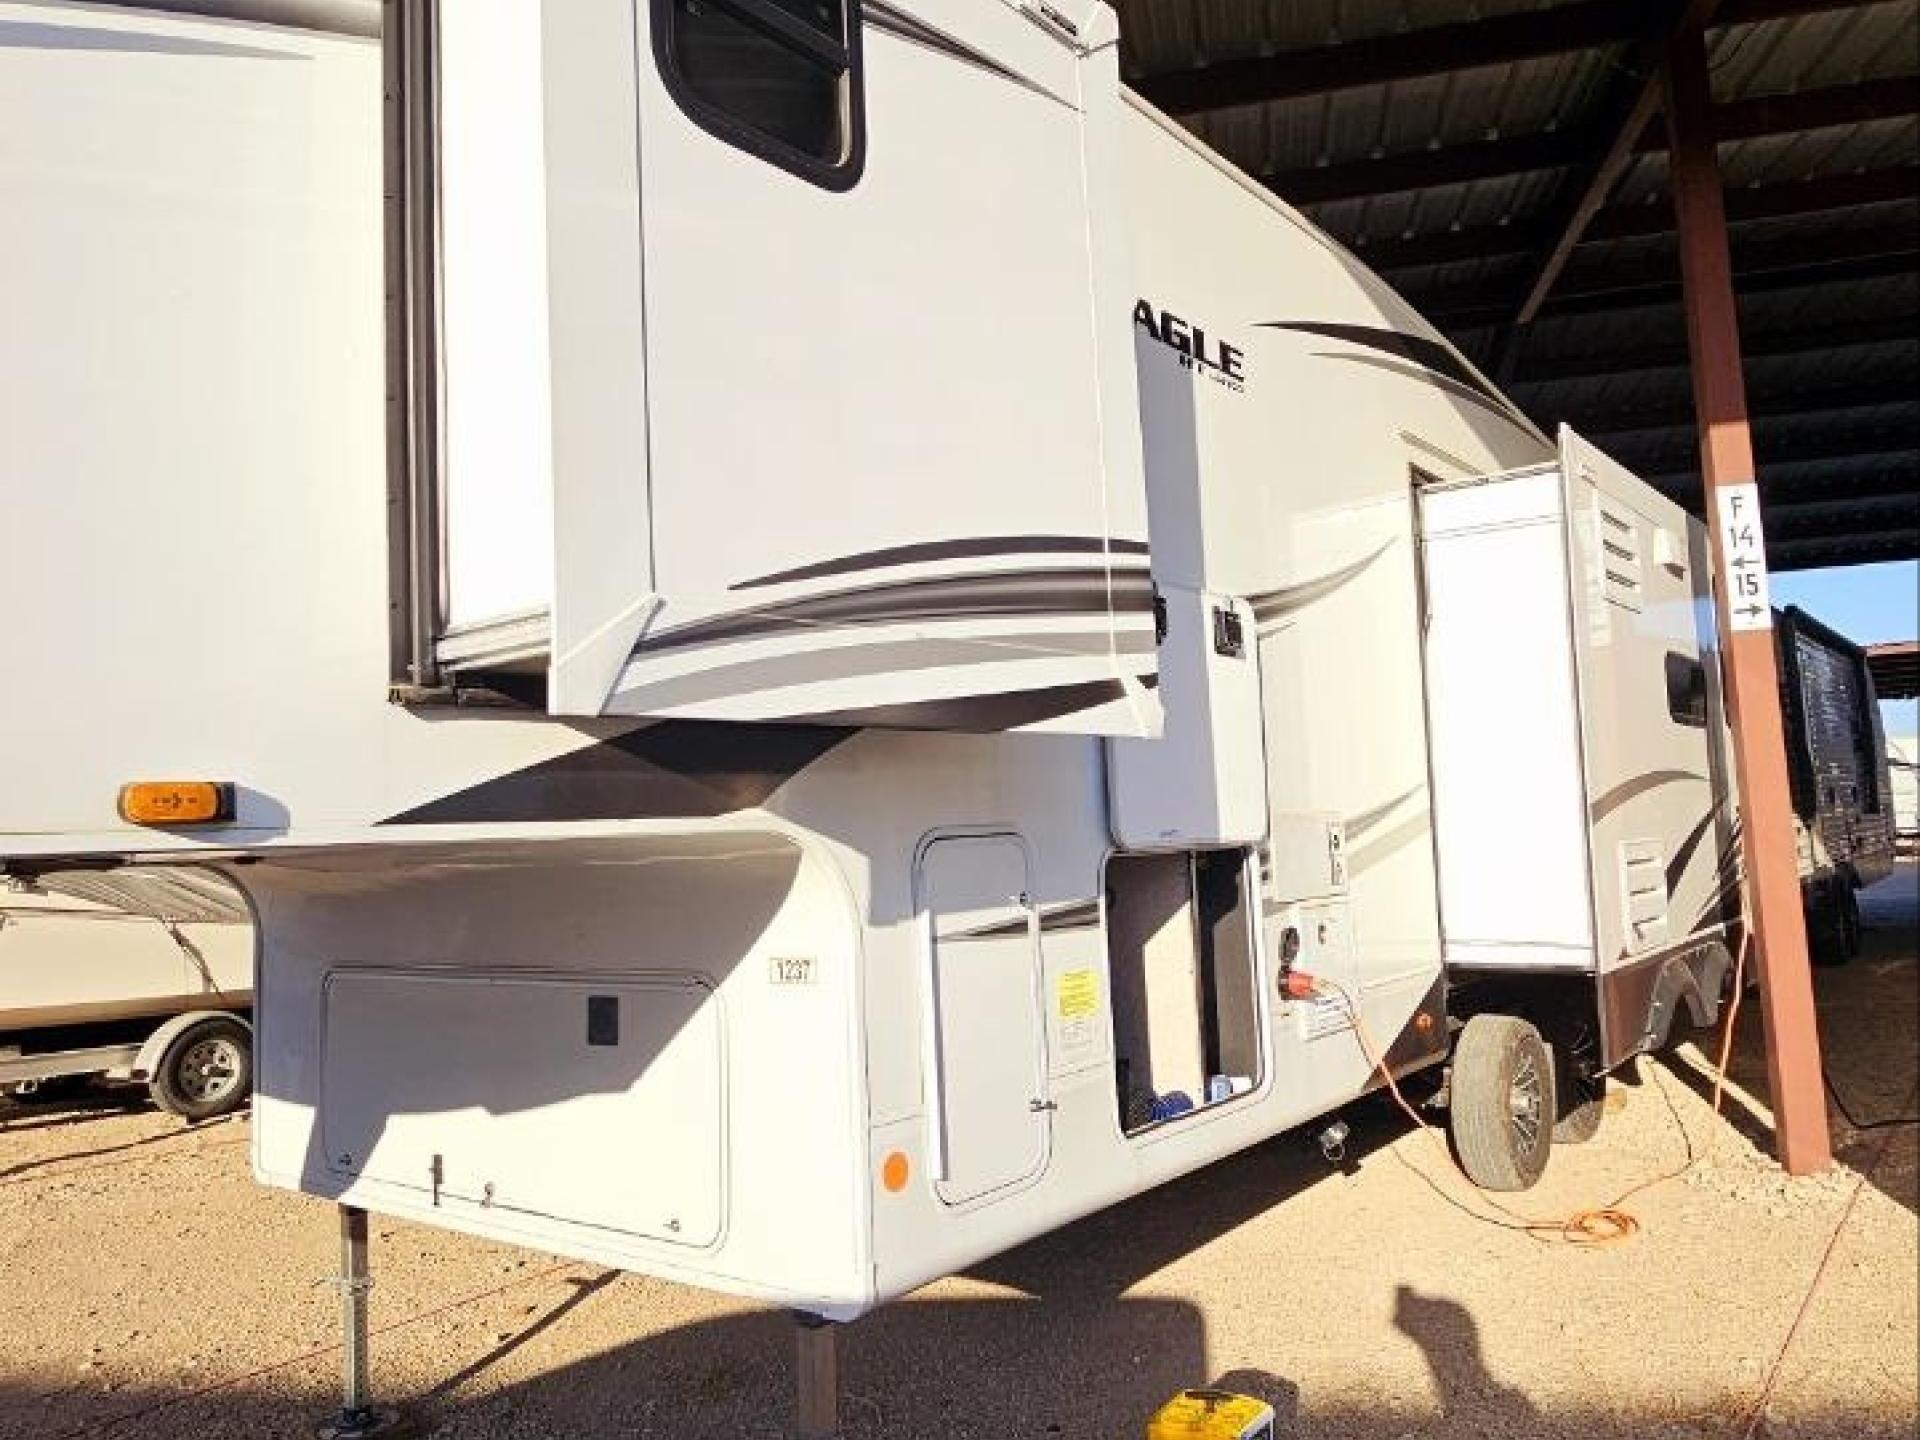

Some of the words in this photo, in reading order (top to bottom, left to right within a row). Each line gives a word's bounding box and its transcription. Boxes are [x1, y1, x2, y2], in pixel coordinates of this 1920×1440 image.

[1730, 495, 1744, 519] F
[1728, 524, 1755, 549] 14
[1735, 573, 1760, 597] 15
